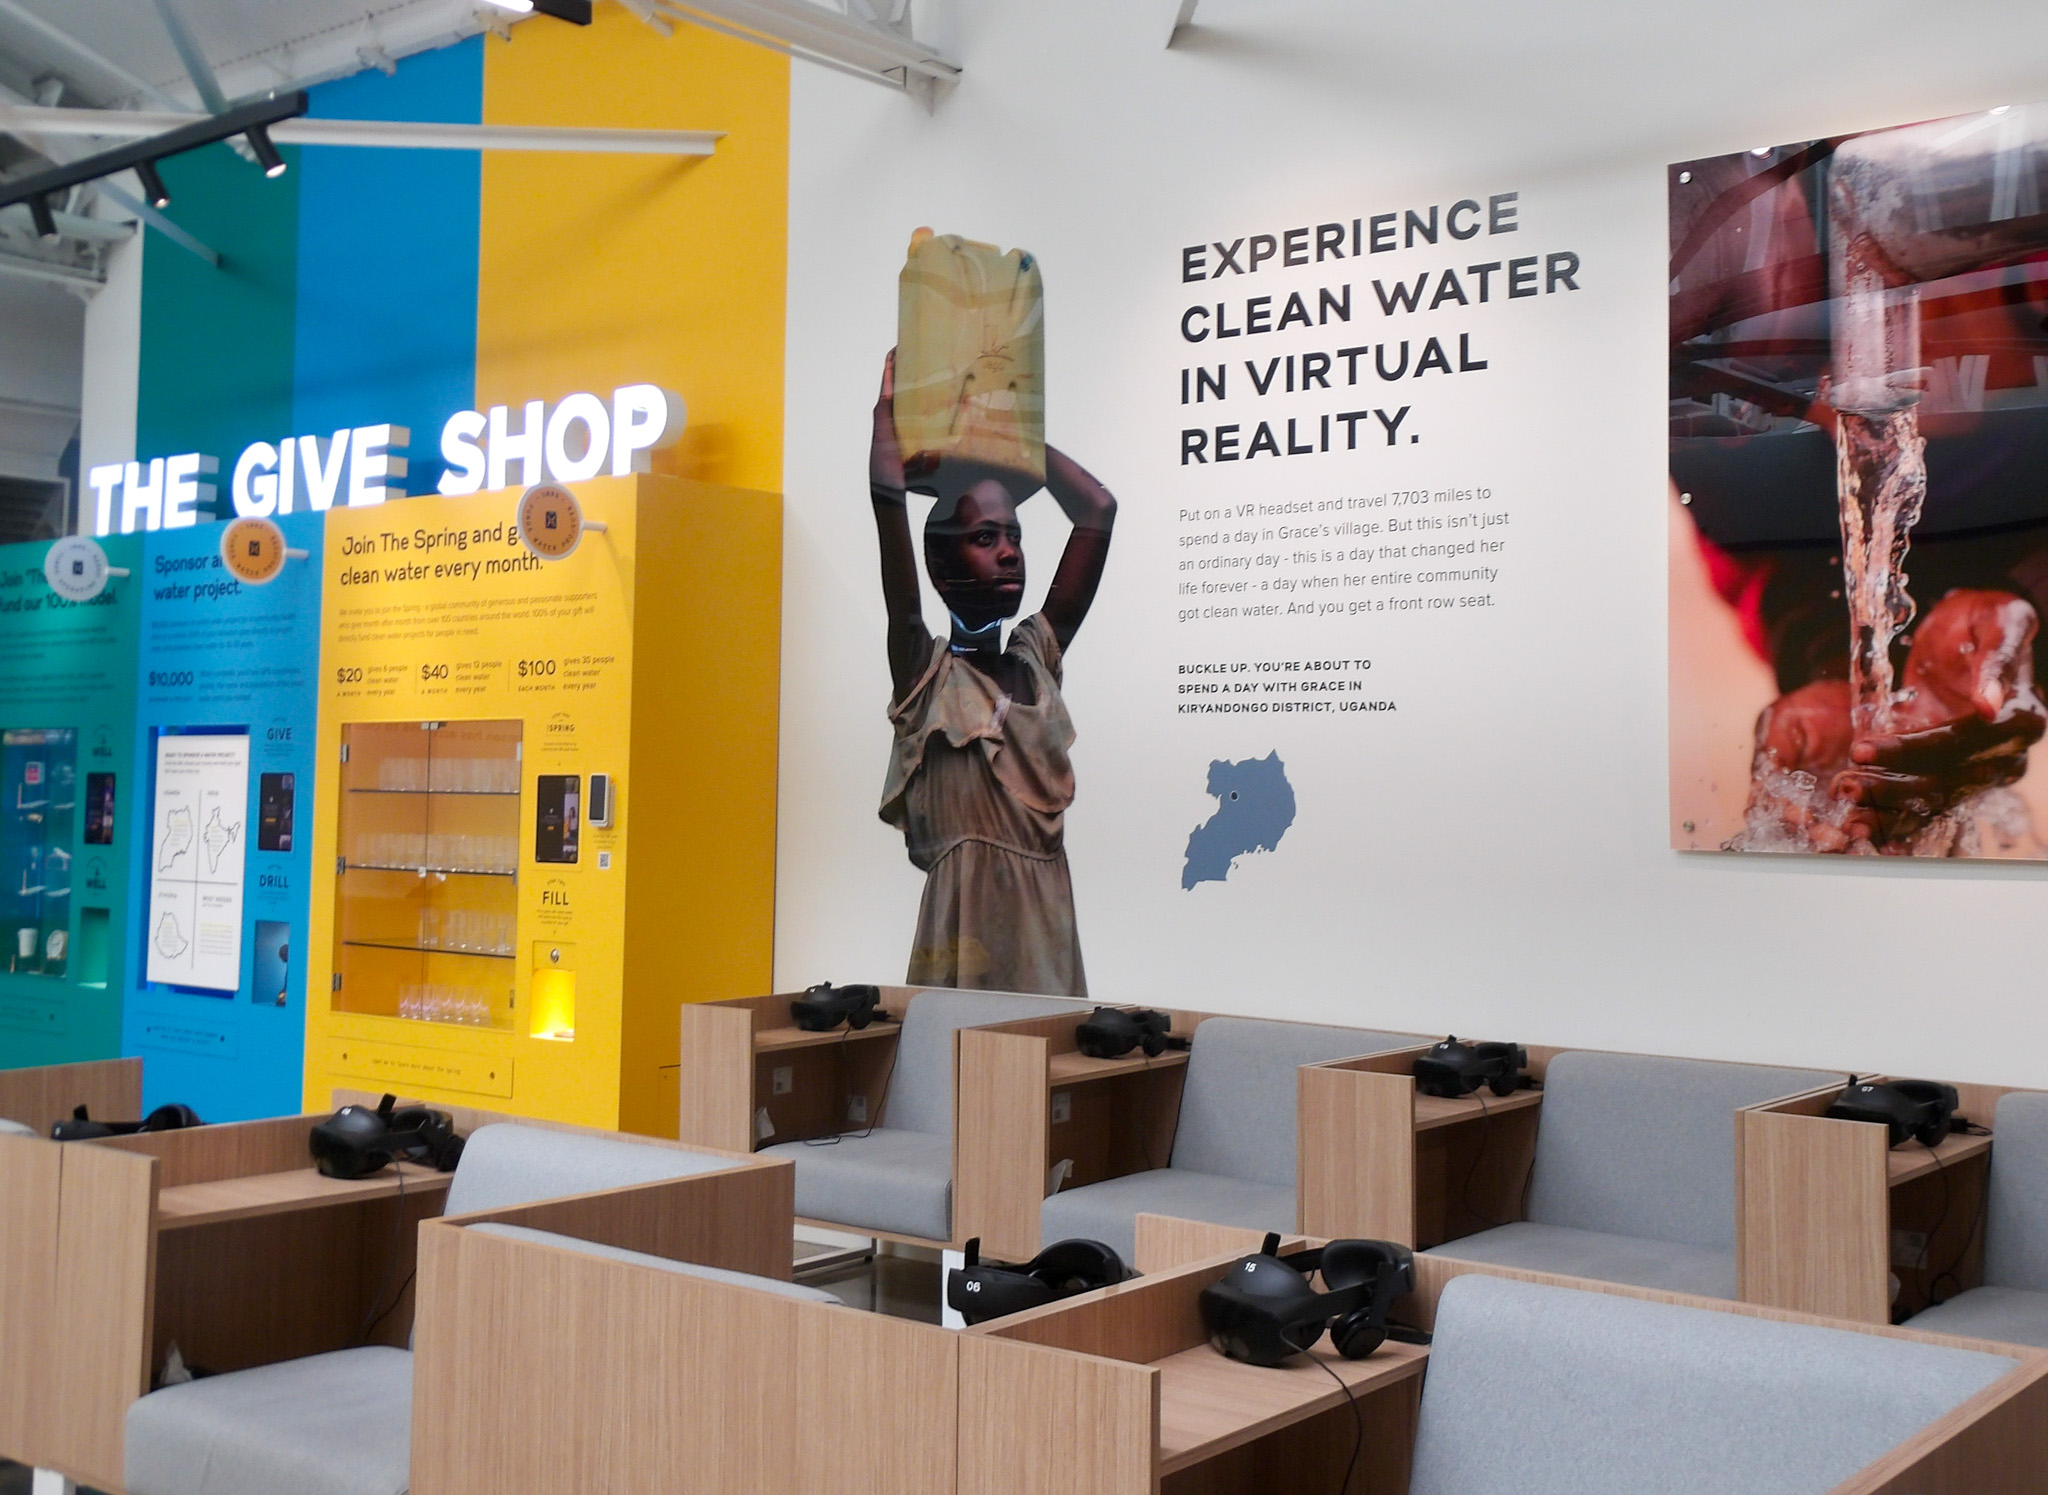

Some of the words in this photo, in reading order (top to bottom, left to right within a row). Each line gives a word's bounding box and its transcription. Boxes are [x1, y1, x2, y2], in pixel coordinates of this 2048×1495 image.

[1182, 191, 1518, 283] EXPERIENCE
[1181, 284, 1351, 343] CLEAN
[1372, 251, 1580, 316] WATER
[1181, 364, 1226, 404] IN
[1245, 333, 1488, 395] VIRTUAL
[1181, 405, 1419, 465] REALITY.
[89, 452, 200, 537] THE
[232, 423, 391, 517] GIVE
[436, 383, 668, 496] SHOP
[1179, 509, 1199, 522] Put
[1204, 509, 1220, 520] on
[1224, 508, 1232, 518] a
[1236, 504, 1255, 518] VR
[1259, 501, 1313, 516] headset
[1318, 497, 1343, 512] and
[1348, 494, 1387, 510] travel
[1392, 490, 1430, 507] 7,703
[1434, 488, 1472, 503] miles
[1477, 487, 1491, 499] to
[343, 536, 375, 555] Join
[381, 533, 409, 552] The
[414, 527, 467, 553] Spring
[472, 522, 502, 543] and
[1179, 531, 1218, 547] spend
[1222, 533, 1230, 543] a
[1234, 529, 1258, 545] day
[1262, 527, 1274, 540] in
[1334, 520, 1383, 537] village.
[1388, 518, 1412, 532] But
[1417, 516, 1442, 530] this
[1481, 512, 1509, 526] just
[155, 554, 209, 577] Sponsor
[1179, 559, 1194, 571] an
[1199, 554, 1251, 570] ordinary
[1256, 552, 1280, 567] day
[1292, 550, 1316, 564] this
[1321, 549, 1332, 561] is
[1337, 551, 1344, 561] a
[1349, 547, 1374, 562] day
[1379, 545, 1406, 558] that
[1411, 540, 1475, 558] changed
[1480, 539, 1505, 552] her
[340, 567, 379, 585] clean
[384, 562, 430, 582] water
[435, 561, 481, 580] every
[486, 551, 543, 574] month.
[1178, 582, 1198, 595] life
[1201, 580, 1248, 594] forever
[1261, 580, 1269, 590] a
[1273, 576, 1297, 592] day
[1301, 575, 1338, 589] when
[1343, 573, 1366, 586] her
[1371, 571, 1412, 585] entire
[1417, 566, 1498, 583] community
[154, 582, 190, 601] water
[1178, 608, 1199, 622] got
[1203, 605, 1237, 619] clean
[1242, 603, 1283, 617] water.
[1287, 601, 1314, 615] And
[1319, 602, 1344, 616] you
[1349, 600, 1372, 615] get
[1376, 601, 1384, 611] a
[1389, 597, 1423, 610] front
[1428, 597, 1455, 608] row
[1459, 594, 1495, 607] seat.
[337, 667, 362, 684] $20
[422, 664, 448, 681] $40
[518, 660, 556, 677] $100
[1178, 663, 1227, 674] BUCKLE
[1230, 663, 1250, 673] UP.
[1304, 661, 1350, 671] ABOUT
[1354, 660, 1371, 670] TO
[149, 670, 193, 687] $10,000
[1178, 683, 1218, 694] SPEND
[1222, 684, 1230, 693] A
[1234, 682, 1259, 693] DAY
[1262, 682, 1297, 692] WITH
[1301, 681, 1345, 691] GRACE
[1349, 681, 1362, 691] IN
[1178, 703, 1268, 714] KIRYANDONGO
[1272, 702, 1335, 713] DISTRICT,
[1340, 701, 1397, 712] UGANDA
[267, 727, 293, 741] GIVE
[259, 874, 290, 888] DRILL
[543, 891, 569, 905] FILL
[1244, 1261, 1258, 1273] 15
[966, 1280, 981, 1293] 06
